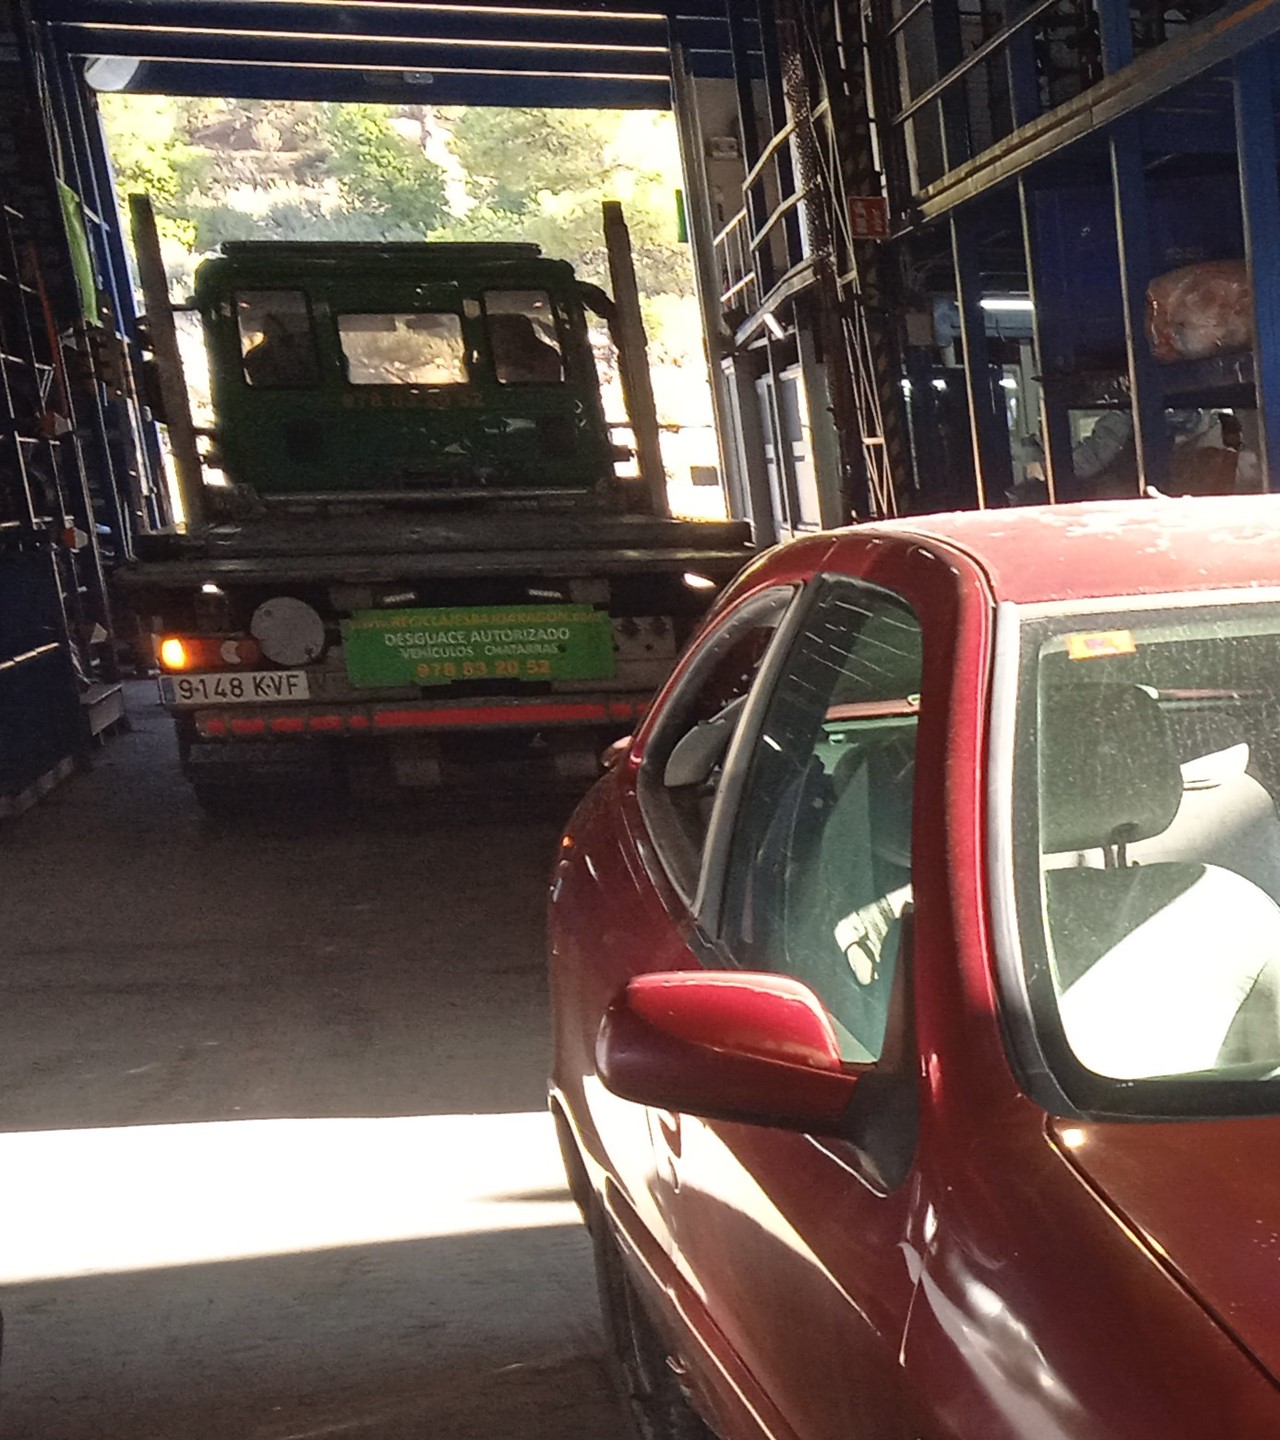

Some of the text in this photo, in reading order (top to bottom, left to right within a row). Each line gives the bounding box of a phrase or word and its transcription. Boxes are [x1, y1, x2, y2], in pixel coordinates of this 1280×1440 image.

[385, 627, 570, 646] DESGUACE AUTORIZADO
[178, 674, 300, 700] 9148 KVF
